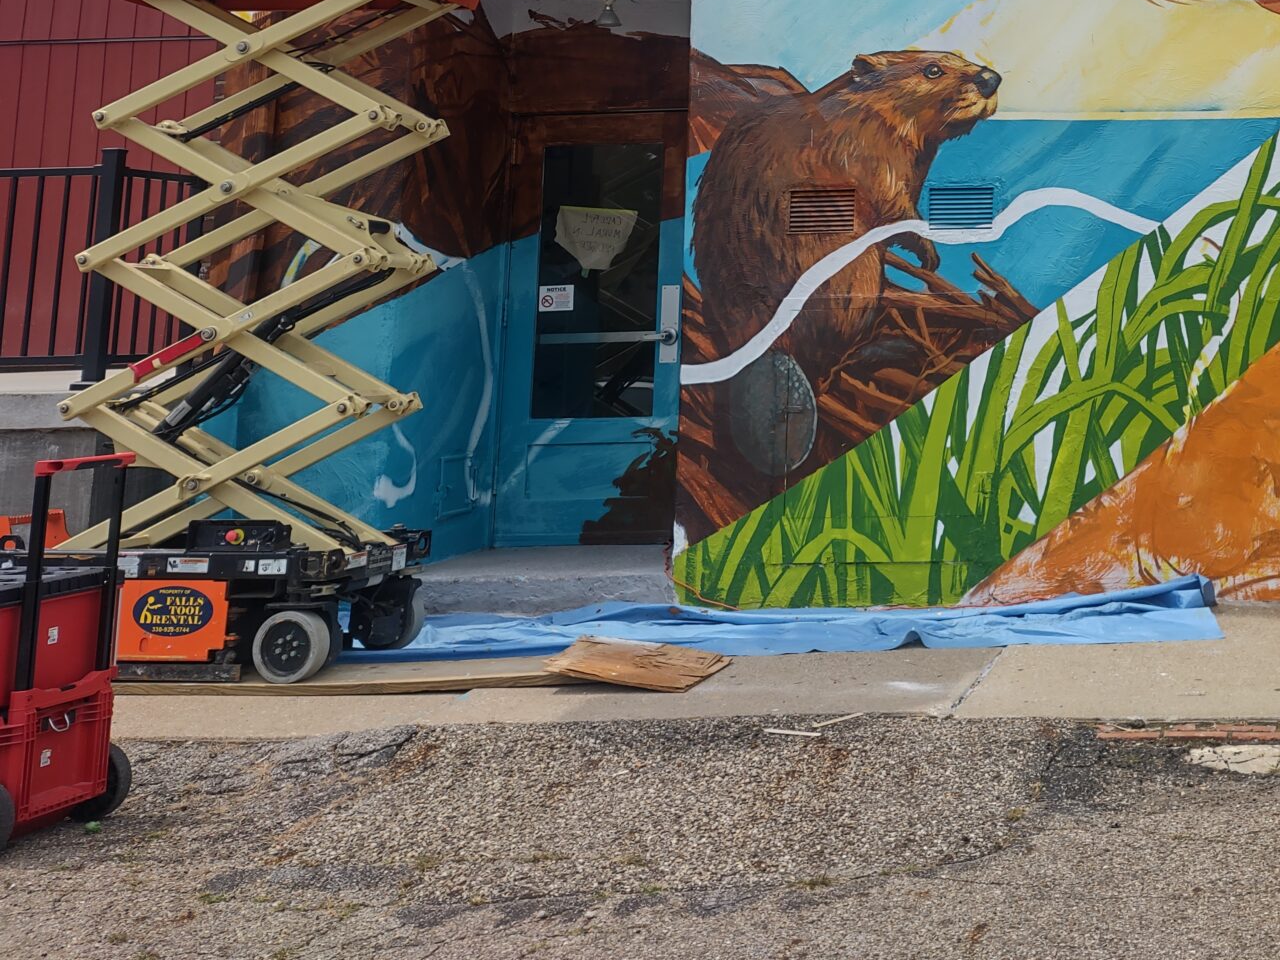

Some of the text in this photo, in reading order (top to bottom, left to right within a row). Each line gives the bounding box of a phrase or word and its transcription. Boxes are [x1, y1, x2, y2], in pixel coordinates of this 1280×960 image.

[166, 596, 204, 606] FALLS
[168, 605, 203, 615] TOOL
[152, 614, 202, 625] RENTAL
